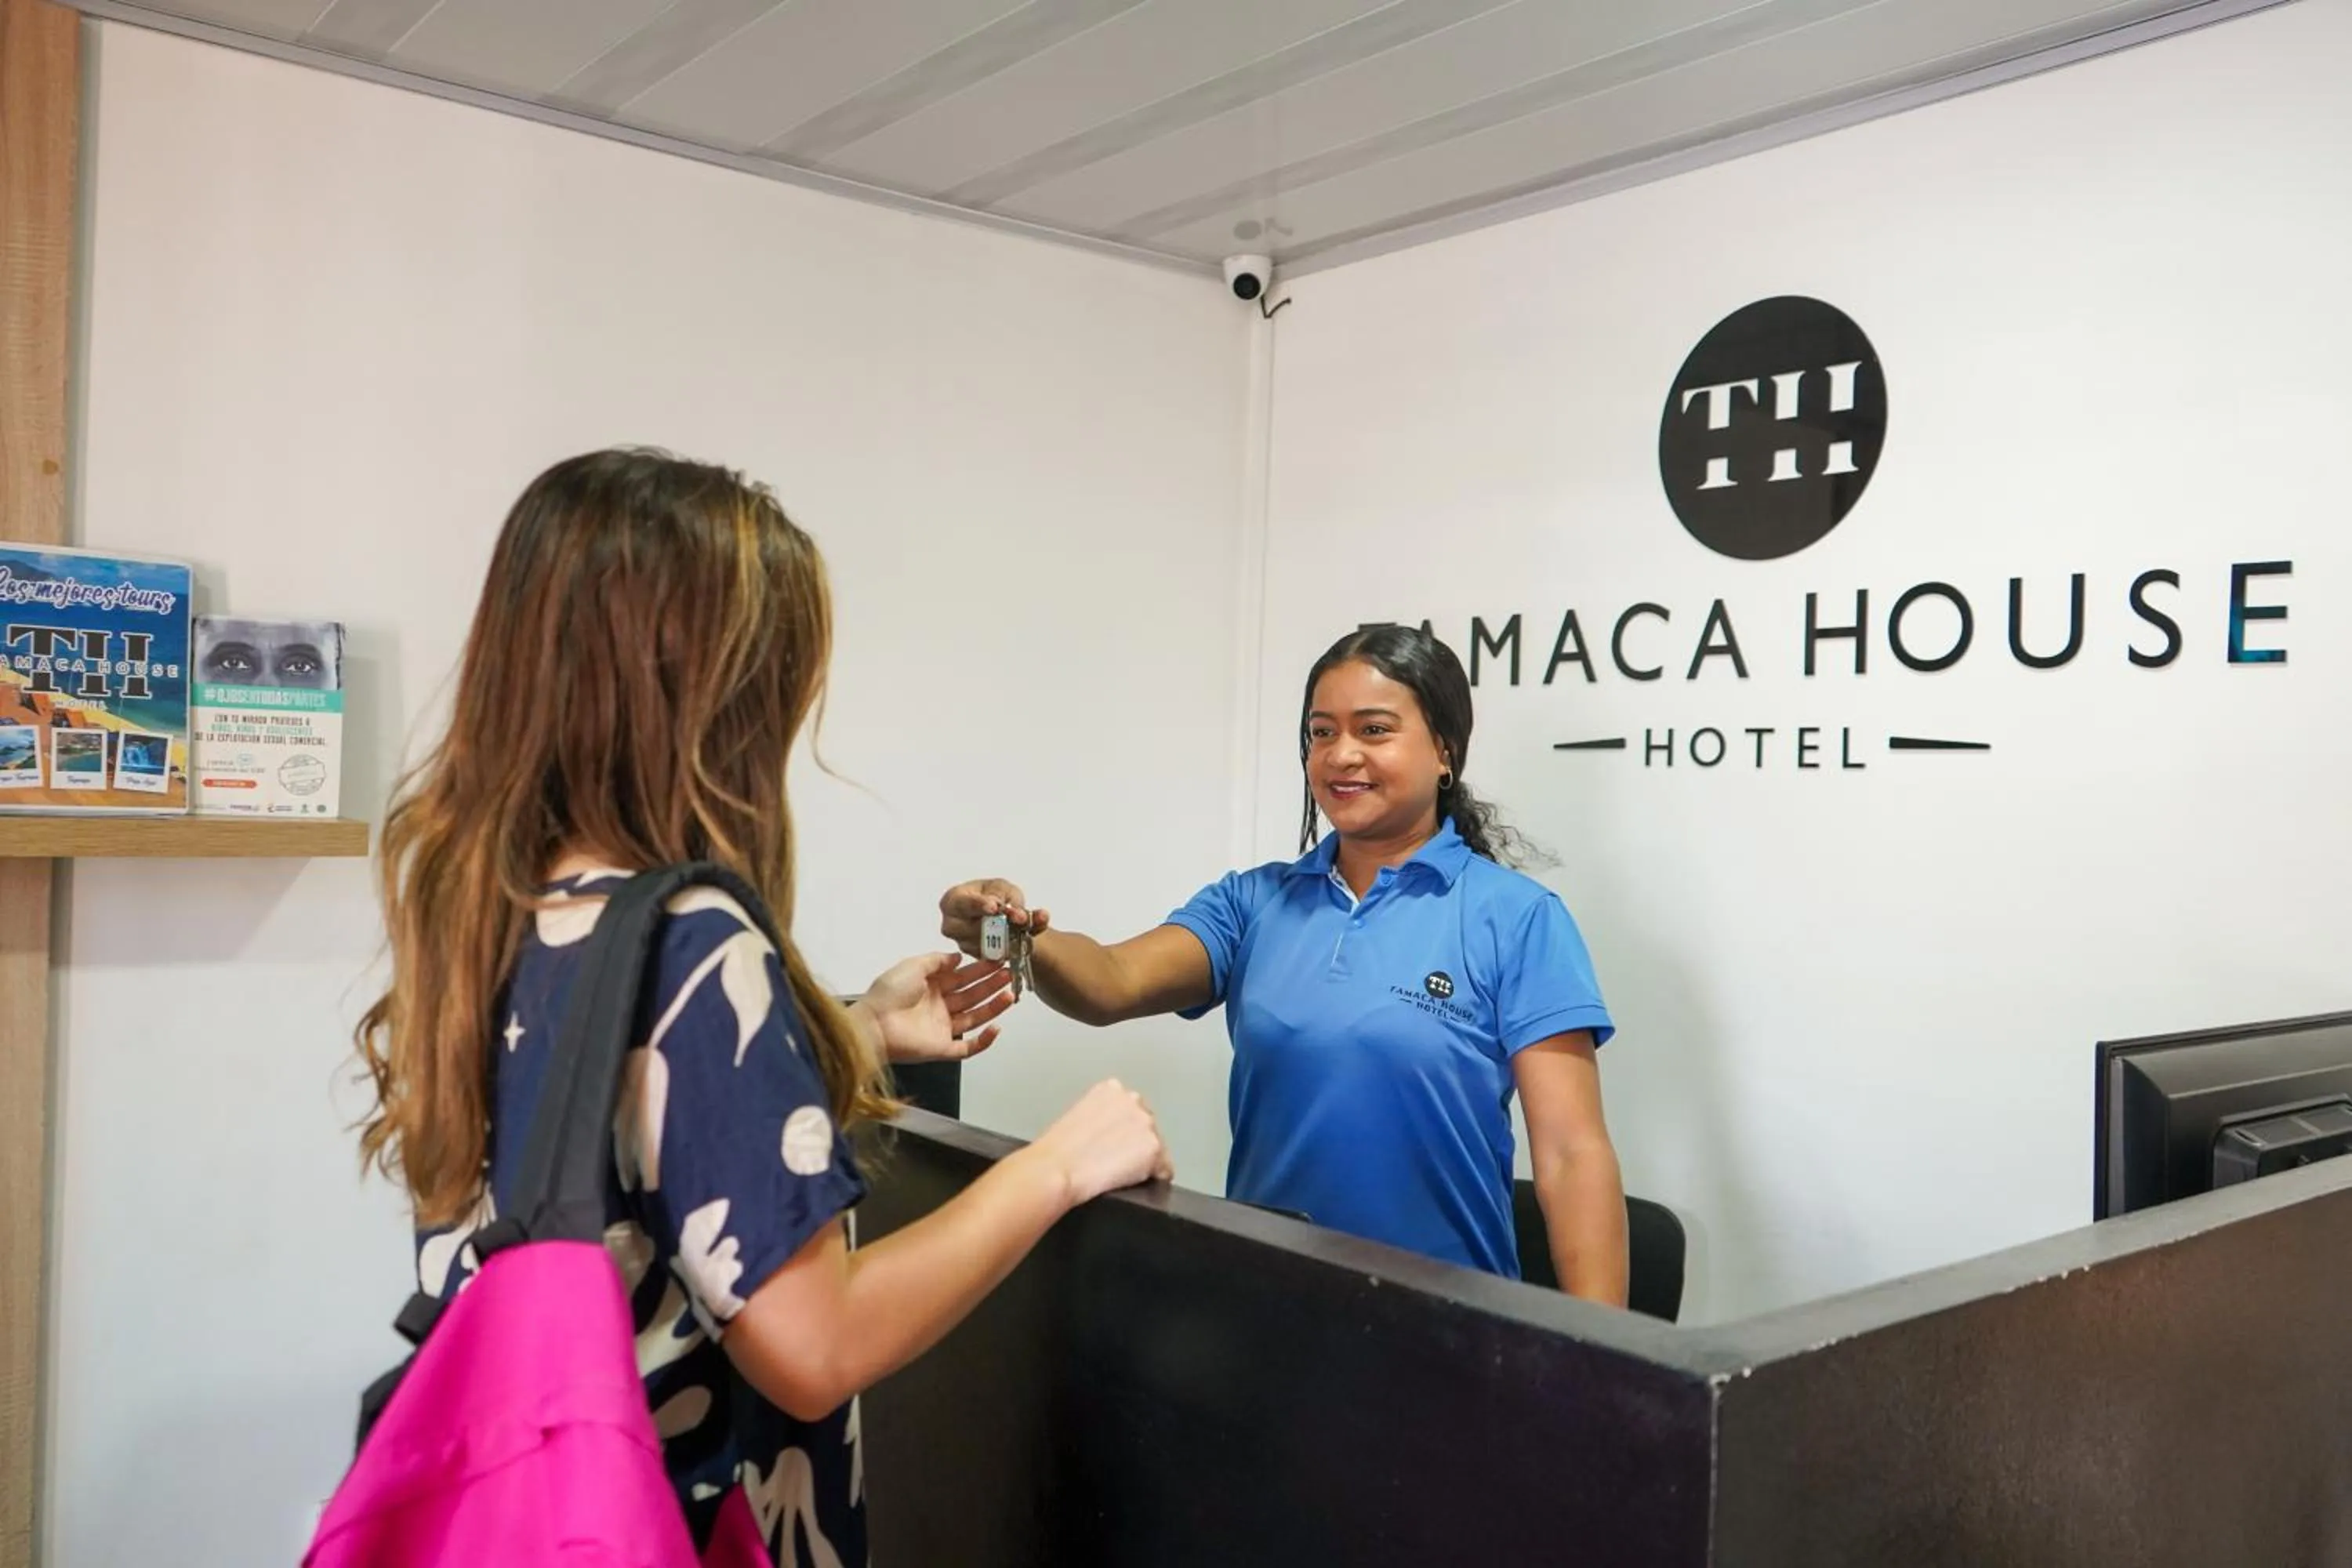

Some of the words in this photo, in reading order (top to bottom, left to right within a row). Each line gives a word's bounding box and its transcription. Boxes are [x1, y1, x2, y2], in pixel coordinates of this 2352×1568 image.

[1681, 361, 1863, 492] TH
[33, 576, 116, 609] mejores
[118, 581, 176, 615] tours
[1359, 598, 1750, 687] MACA
[1804, 560, 2293, 677] HOUSE
[97, 660, 179, 678] HOUSE
[1644, 726, 1867, 768] HOTEL
[986, 935, 1002, 949] 101
[1389, 985, 1436, 1005] TAMACA
[1416, 1001, 1448, 1020] HOTEL
